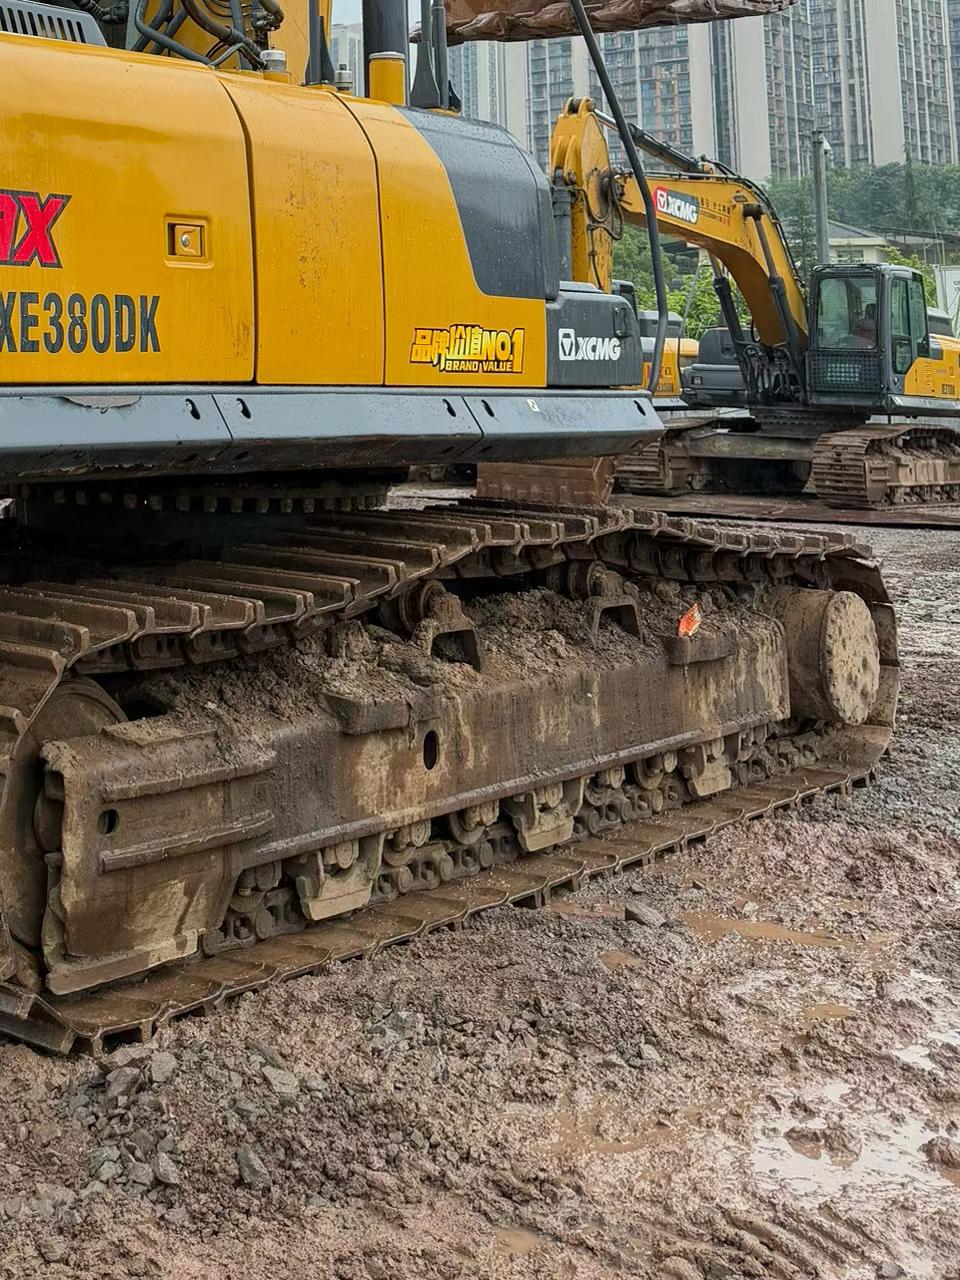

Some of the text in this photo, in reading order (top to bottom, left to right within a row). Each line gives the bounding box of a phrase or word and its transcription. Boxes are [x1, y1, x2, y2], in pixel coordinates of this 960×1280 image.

[667, 195, 699, 224] XCMG
[576, 336, 621, 361] XCMG
[445, 360, 513, 372] BRAND VALUE
